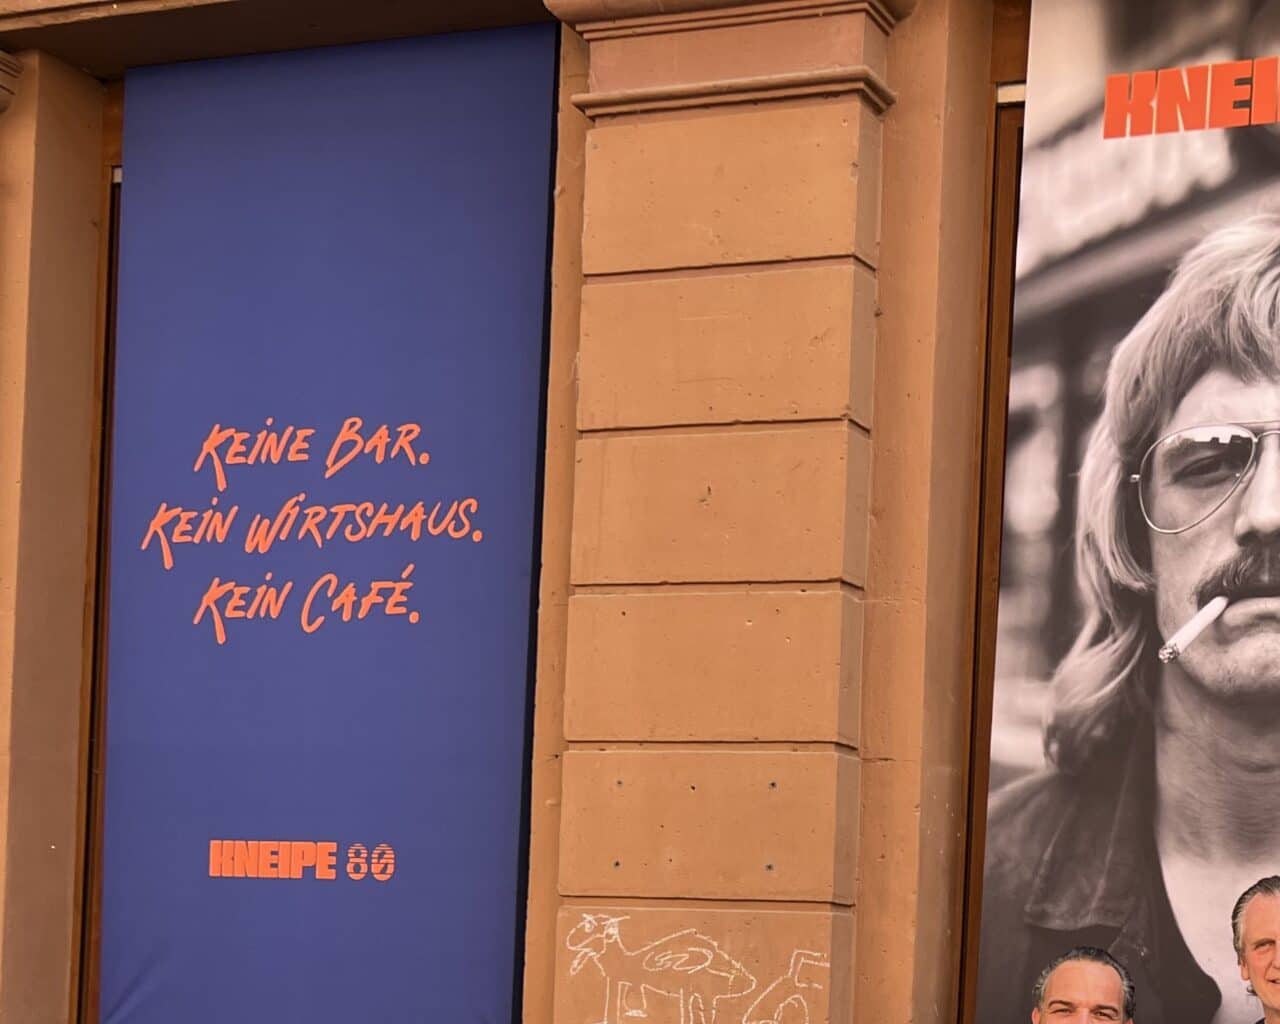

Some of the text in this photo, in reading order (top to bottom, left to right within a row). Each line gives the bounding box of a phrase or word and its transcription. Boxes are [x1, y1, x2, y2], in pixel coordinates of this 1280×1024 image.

[194, 416, 430, 491] KEINE BAR.
[141, 493, 484, 570] KEIN WIRTSHAUS.
[194, 564, 420, 645] KEIN CAFÉ.
[209, 840, 395, 881] KNEIPE 80
